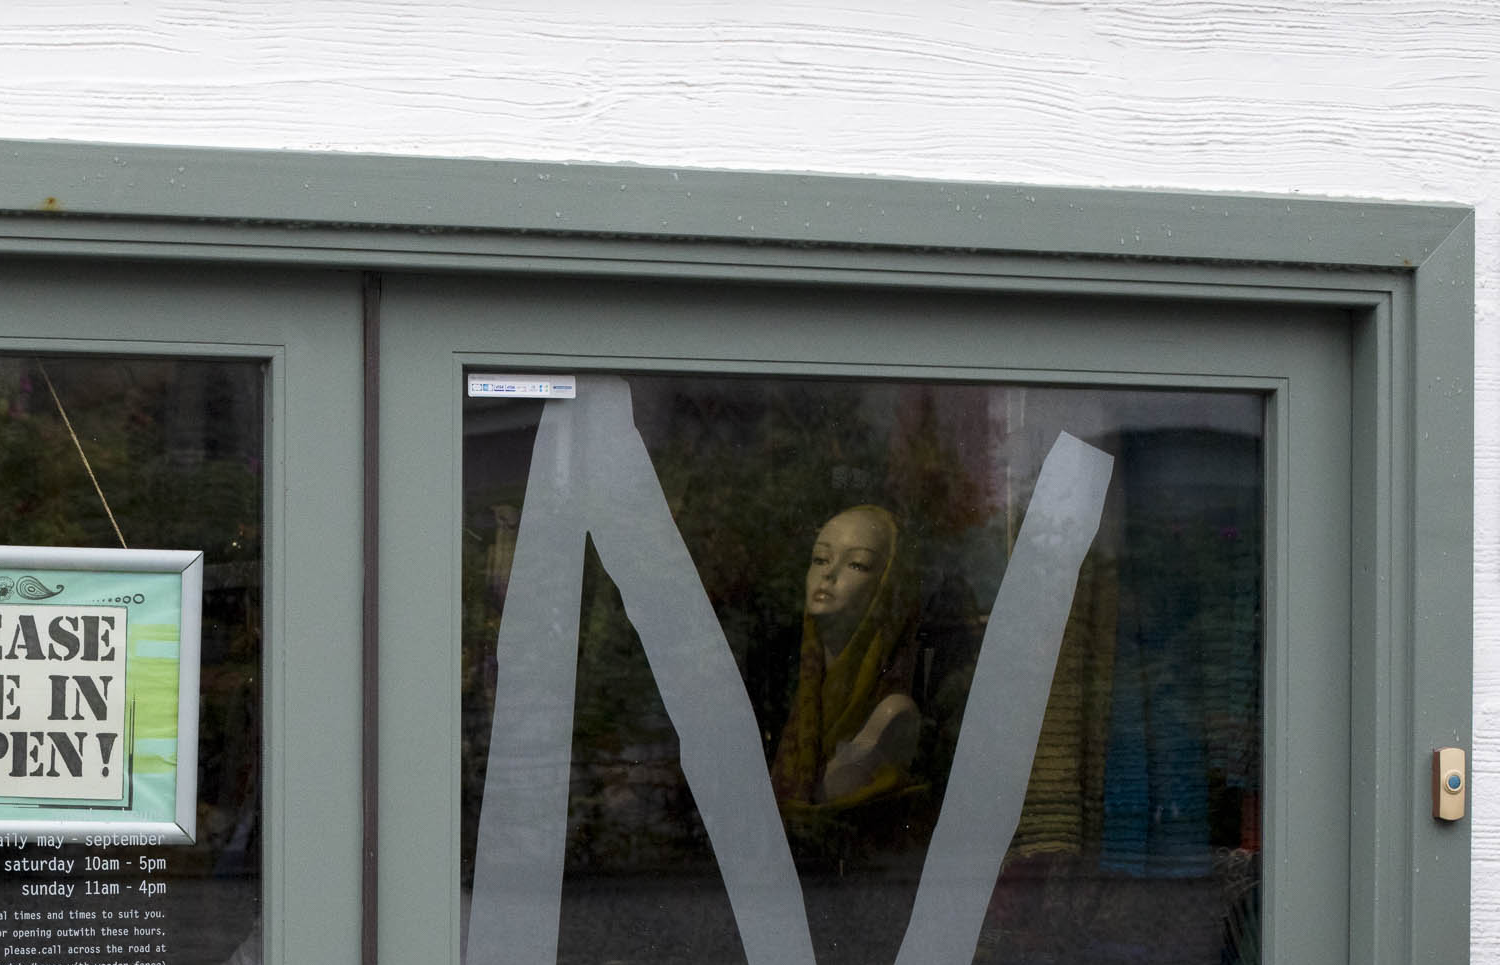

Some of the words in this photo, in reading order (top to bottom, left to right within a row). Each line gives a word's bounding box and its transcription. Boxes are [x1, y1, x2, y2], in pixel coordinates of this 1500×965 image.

[48, 674, 113, 722] IN
[37, 836, 64, 848] may
[85, 832, 166, 848] september
[4, 857, 74, 873] saturday
[84, 856, 119, 870] 10am
[139, 856, 167, 872] 5pm
[22, 880, 75, 897] sunday
[85, 881, 120, 895] 11am
[139, 880, 167, 897] 4pm
[14, 910, 41, 920] times
[47, 910, 64, 919] and
[69, 910, 97, 919] times
[102, 910, 113, 919] to
[118, 909, 140, 919] suit
[144, 910, 165, 920] you.
[13, 928, 52, 939] opening
[56, 927, 96, 937] outwith
[101, 927, 129, 936] these
[67, 946, 101, 954] across
[106, 944, 123, 953] the
[128, 944, 150, 953] road
[155, 944, 167, 953] at
